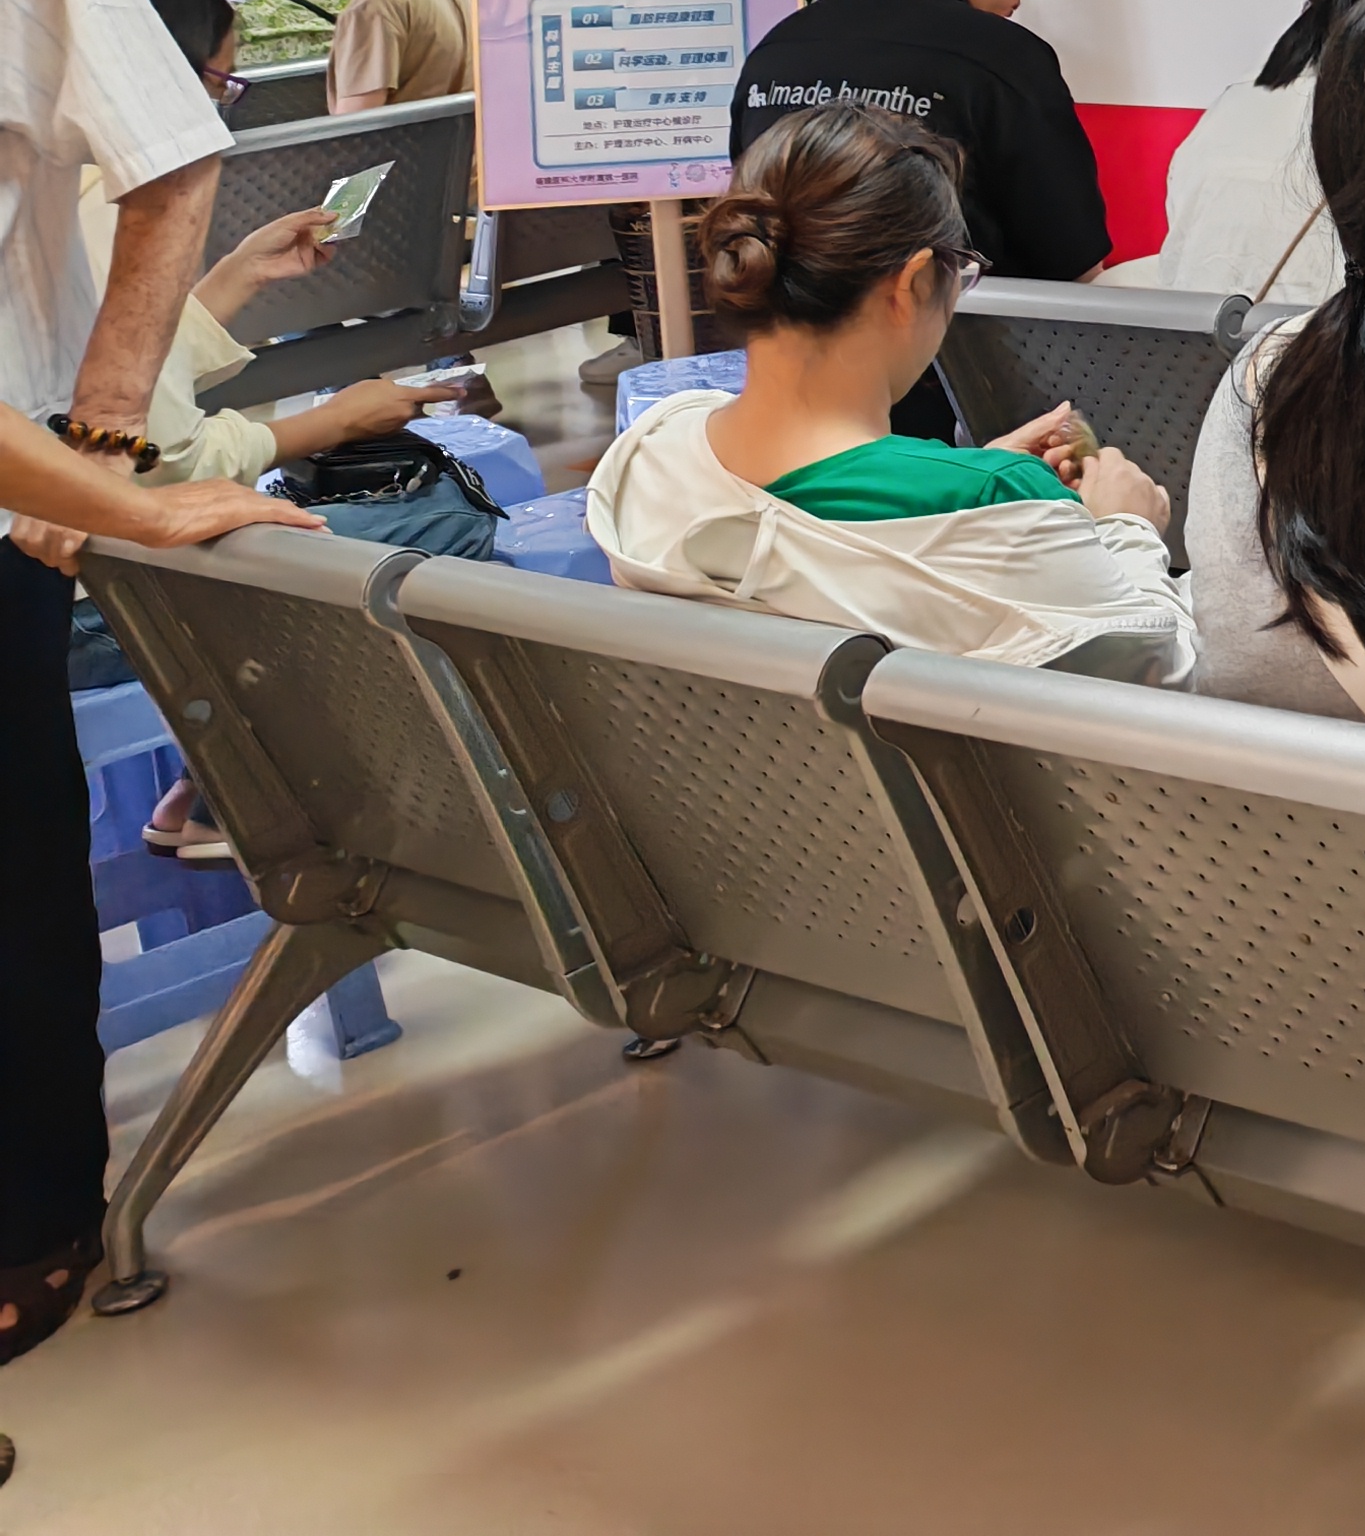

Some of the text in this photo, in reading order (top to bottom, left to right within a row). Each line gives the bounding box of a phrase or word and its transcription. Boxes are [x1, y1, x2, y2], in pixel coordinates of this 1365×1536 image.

[582, 13, 599, 24] 01
[584, 53, 602, 64] 02
[586, 95, 605, 106] 03
